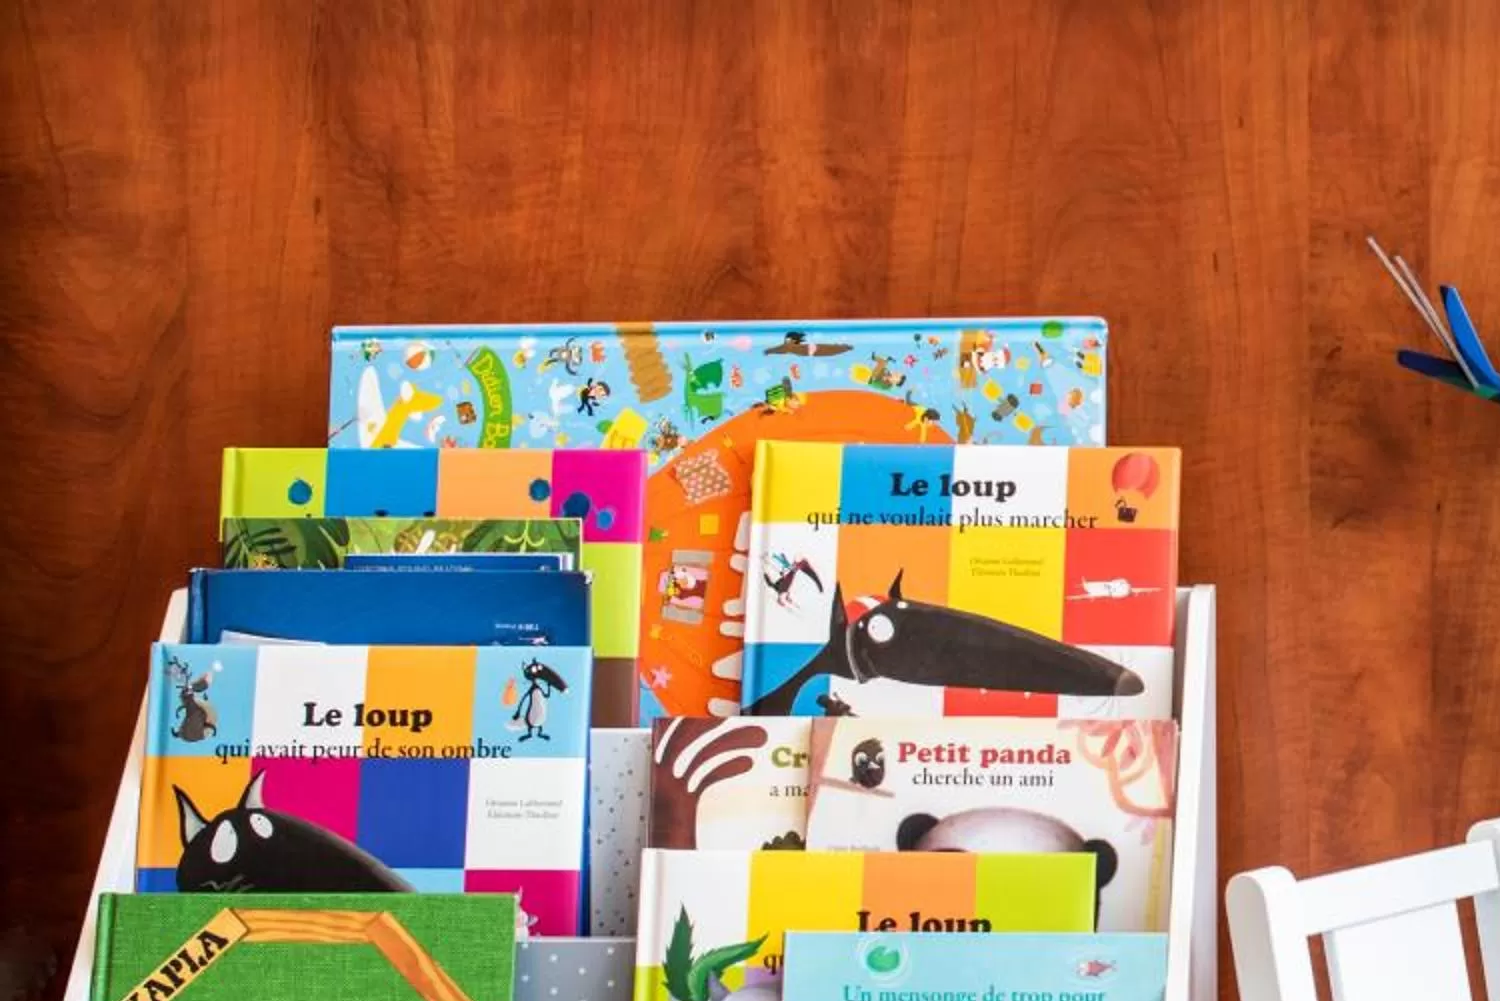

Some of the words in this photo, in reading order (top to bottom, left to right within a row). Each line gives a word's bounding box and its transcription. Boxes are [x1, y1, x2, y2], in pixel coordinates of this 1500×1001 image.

[890, 472, 929, 498] Le
[939, 473, 1017, 503] loup
[807, 508, 841, 531] qui
[848, 513, 873, 526] ne
[879, 506, 952, 527] voulait
[959, 508, 1003, 533] plus
[1009, 508, 1098, 529] marcher
[303, 702, 343, 727] Le
[354, 703, 433, 732] loup
[215, 738, 250, 764] qui
[256, 740, 306, 759] avait
[310, 743, 362, 764] peur
[367, 738, 392, 759] de
[399, 743, 436, 759] son
[441, 738, 511, 759] ombre
[771, 746, 811, 768] Cr
[897, 742, 973, 764] Petit
[980, 744, 1071, 768] panda
[912, 767, 983, 786] cherche
[990, 772, 1013, 786] un
[1018, 769, 1054, 786] ami
[769, 785, 779, 797] a
[857, 910, 897, 932] Le
